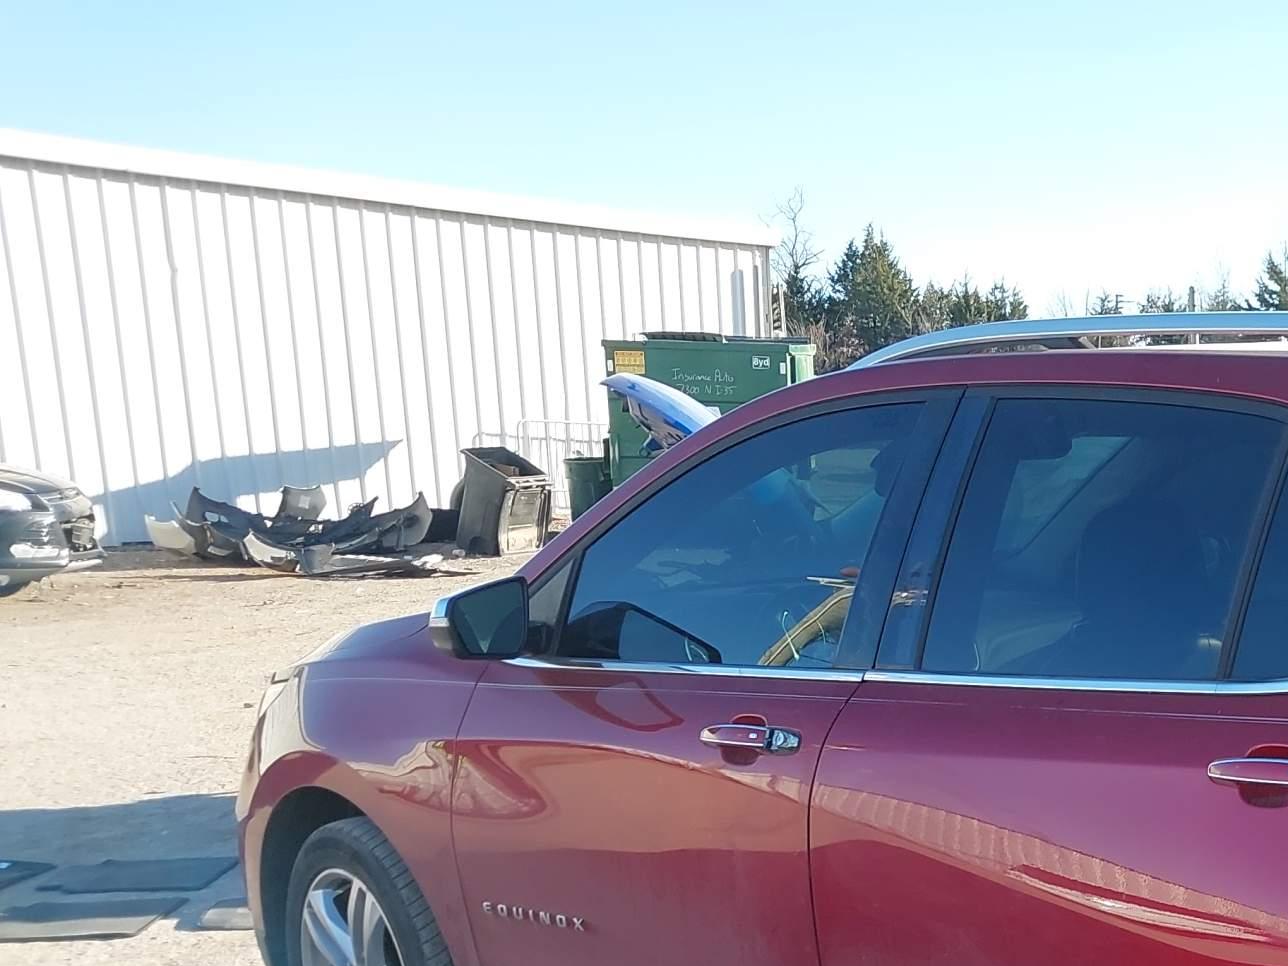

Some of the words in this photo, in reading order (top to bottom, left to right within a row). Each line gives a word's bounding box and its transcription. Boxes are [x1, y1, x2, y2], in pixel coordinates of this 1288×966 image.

[714, 368, 735, 382] Auto
[704, 384, 712, 394] N
[482, 901, 585, 932] EQUINOX
